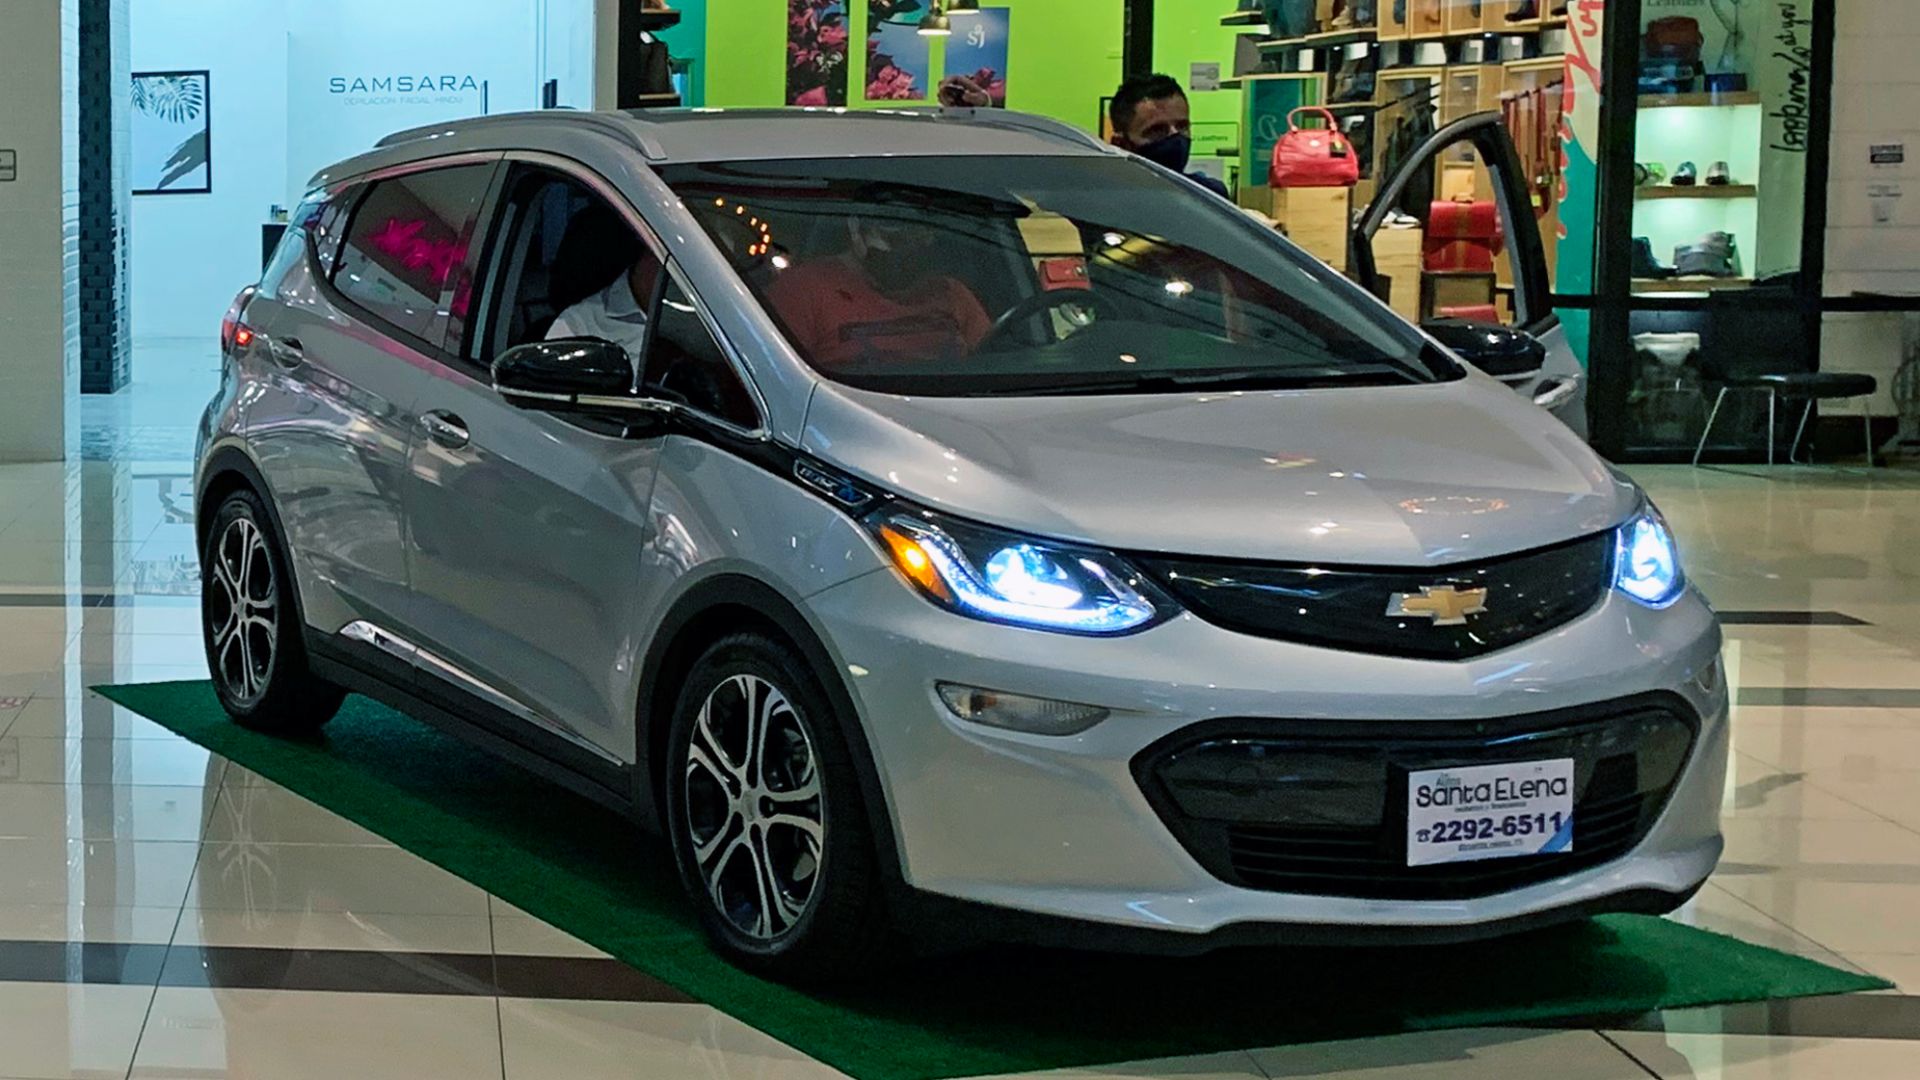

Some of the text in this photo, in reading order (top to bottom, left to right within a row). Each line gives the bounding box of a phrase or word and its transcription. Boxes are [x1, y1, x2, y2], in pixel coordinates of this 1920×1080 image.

[329, 75, 477, 94] SAMSARA
[400, 96, 430, 105] FACIAL
[1416, 783, 1490, 808] Santa
[1431, 812, 1561, 843] 2292-6511
